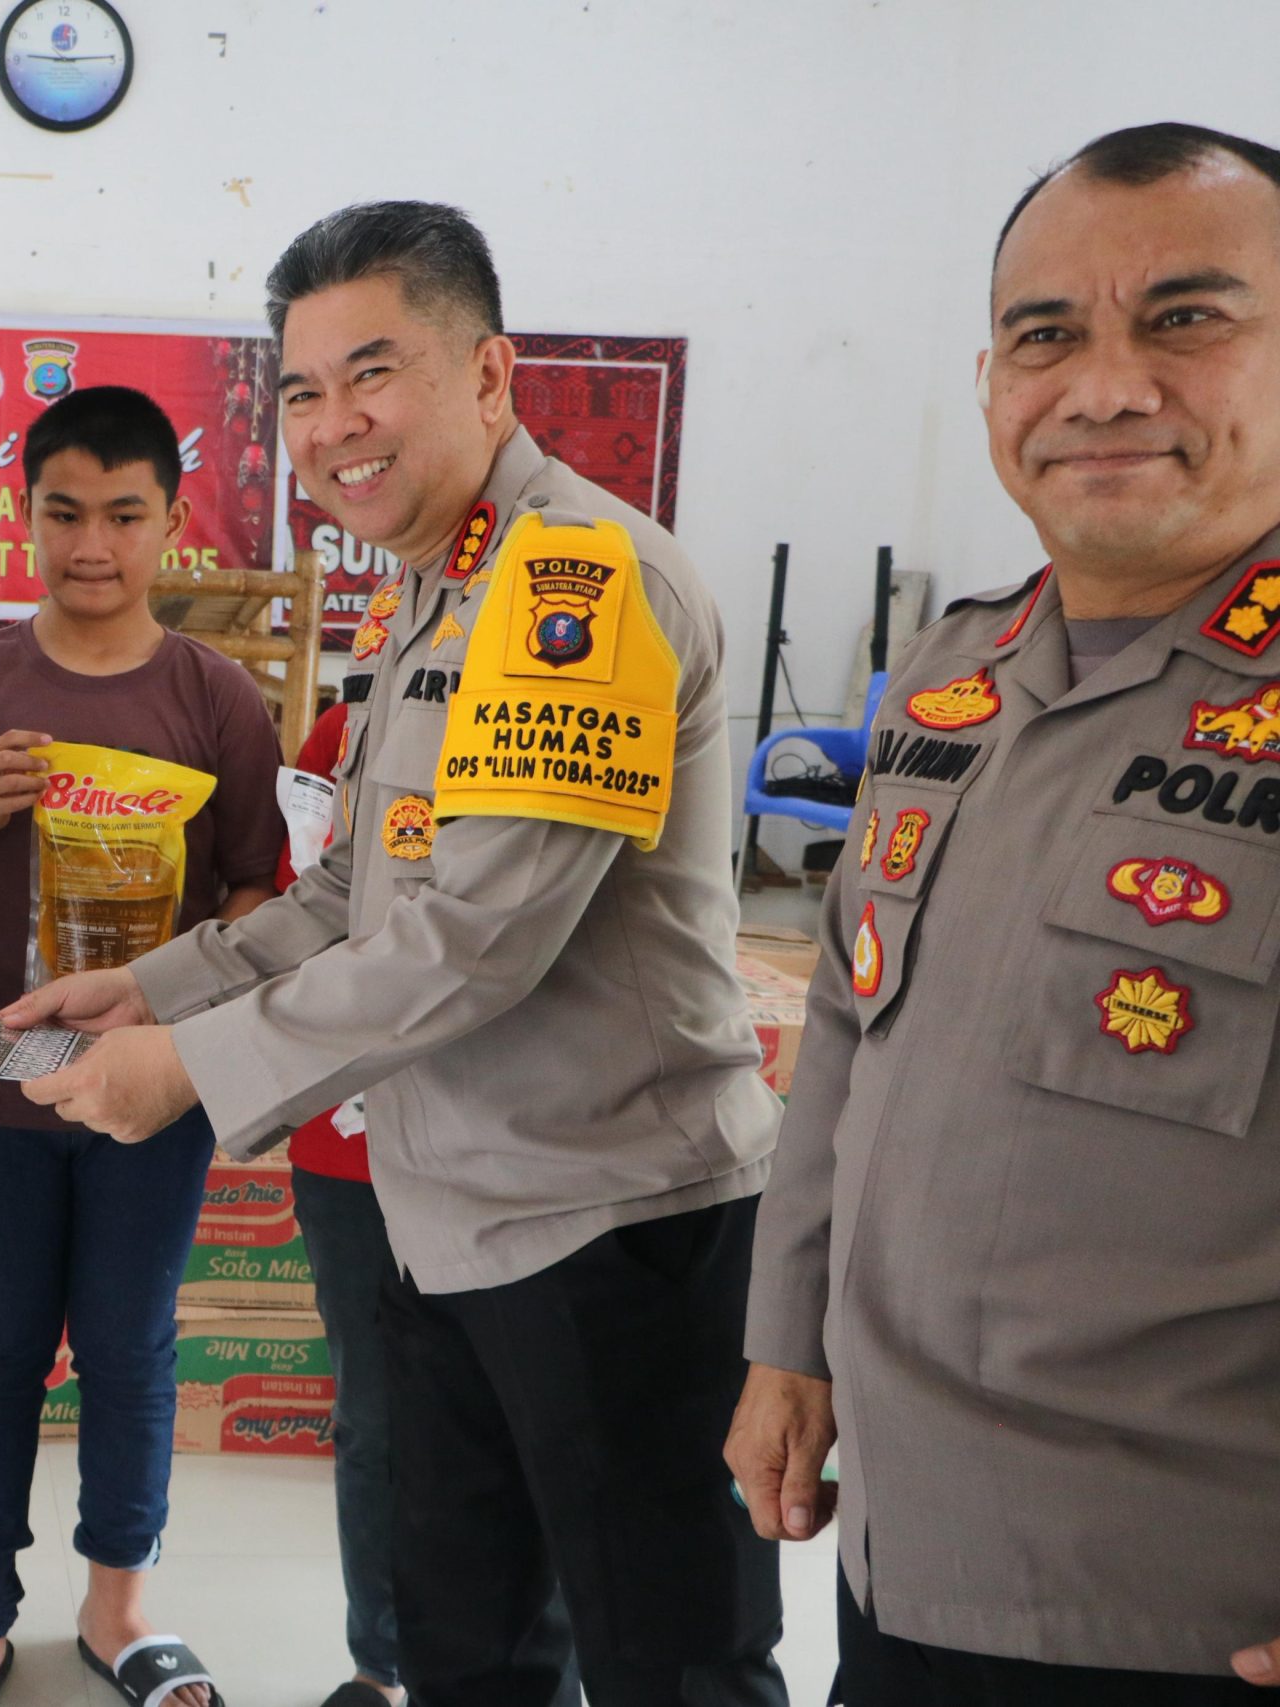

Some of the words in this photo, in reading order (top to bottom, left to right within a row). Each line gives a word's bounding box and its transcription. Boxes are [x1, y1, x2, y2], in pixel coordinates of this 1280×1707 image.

[58, 6, 70, 16] 12
[21, 543, 36, 578] T
[533, 560, 604, 581] POLDA
[535, 581, 573, 592] SUMATERA
[575, 584, 598, 597] UTARA
[474, 701, 642, 739] KASATGAS
[493, 728, 613, 760] HUMAS
[446, 755, 479, 779] OPS
[41, 772, 183, 816] Bimoli
[195, 1227, 212, 1240] Mi
[214, 1229, 256, 1242] Instan
[207, 1256, 262, 1279] Soto
[267, 1259, 311, 1281] Mie
[205, 1340, 250, 1361] Mie
[255, 1341, 311, 1364] Soto
[39, 1402, 80, 1421] Mie
